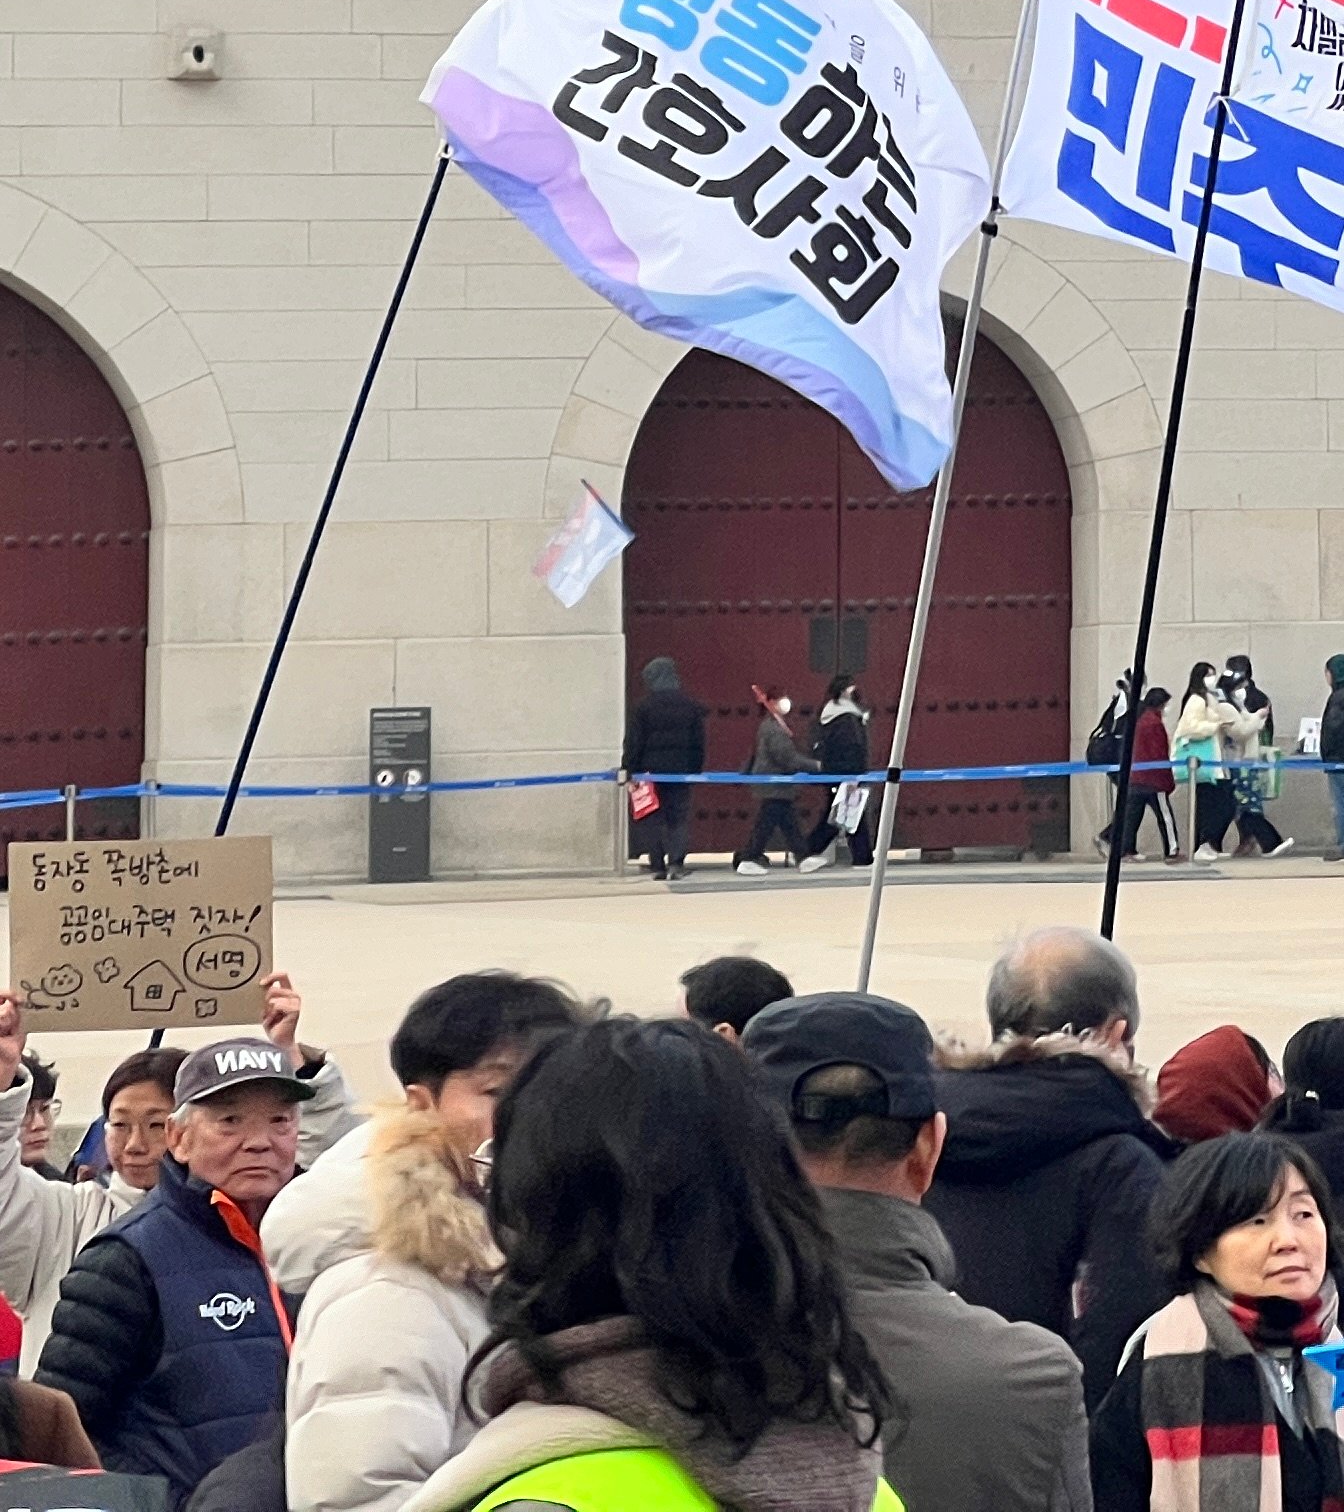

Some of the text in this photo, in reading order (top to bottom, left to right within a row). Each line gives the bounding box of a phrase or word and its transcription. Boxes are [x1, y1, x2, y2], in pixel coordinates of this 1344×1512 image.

[551, 29, 901, 326] 간호사회
[32, 851, 90, 893] 동자동
[60, 905, 262, 946] 공공임대주택 짓자!
[196, 950, 245, 978] 서명
[214, 1049, 283, 1076] NAVY
